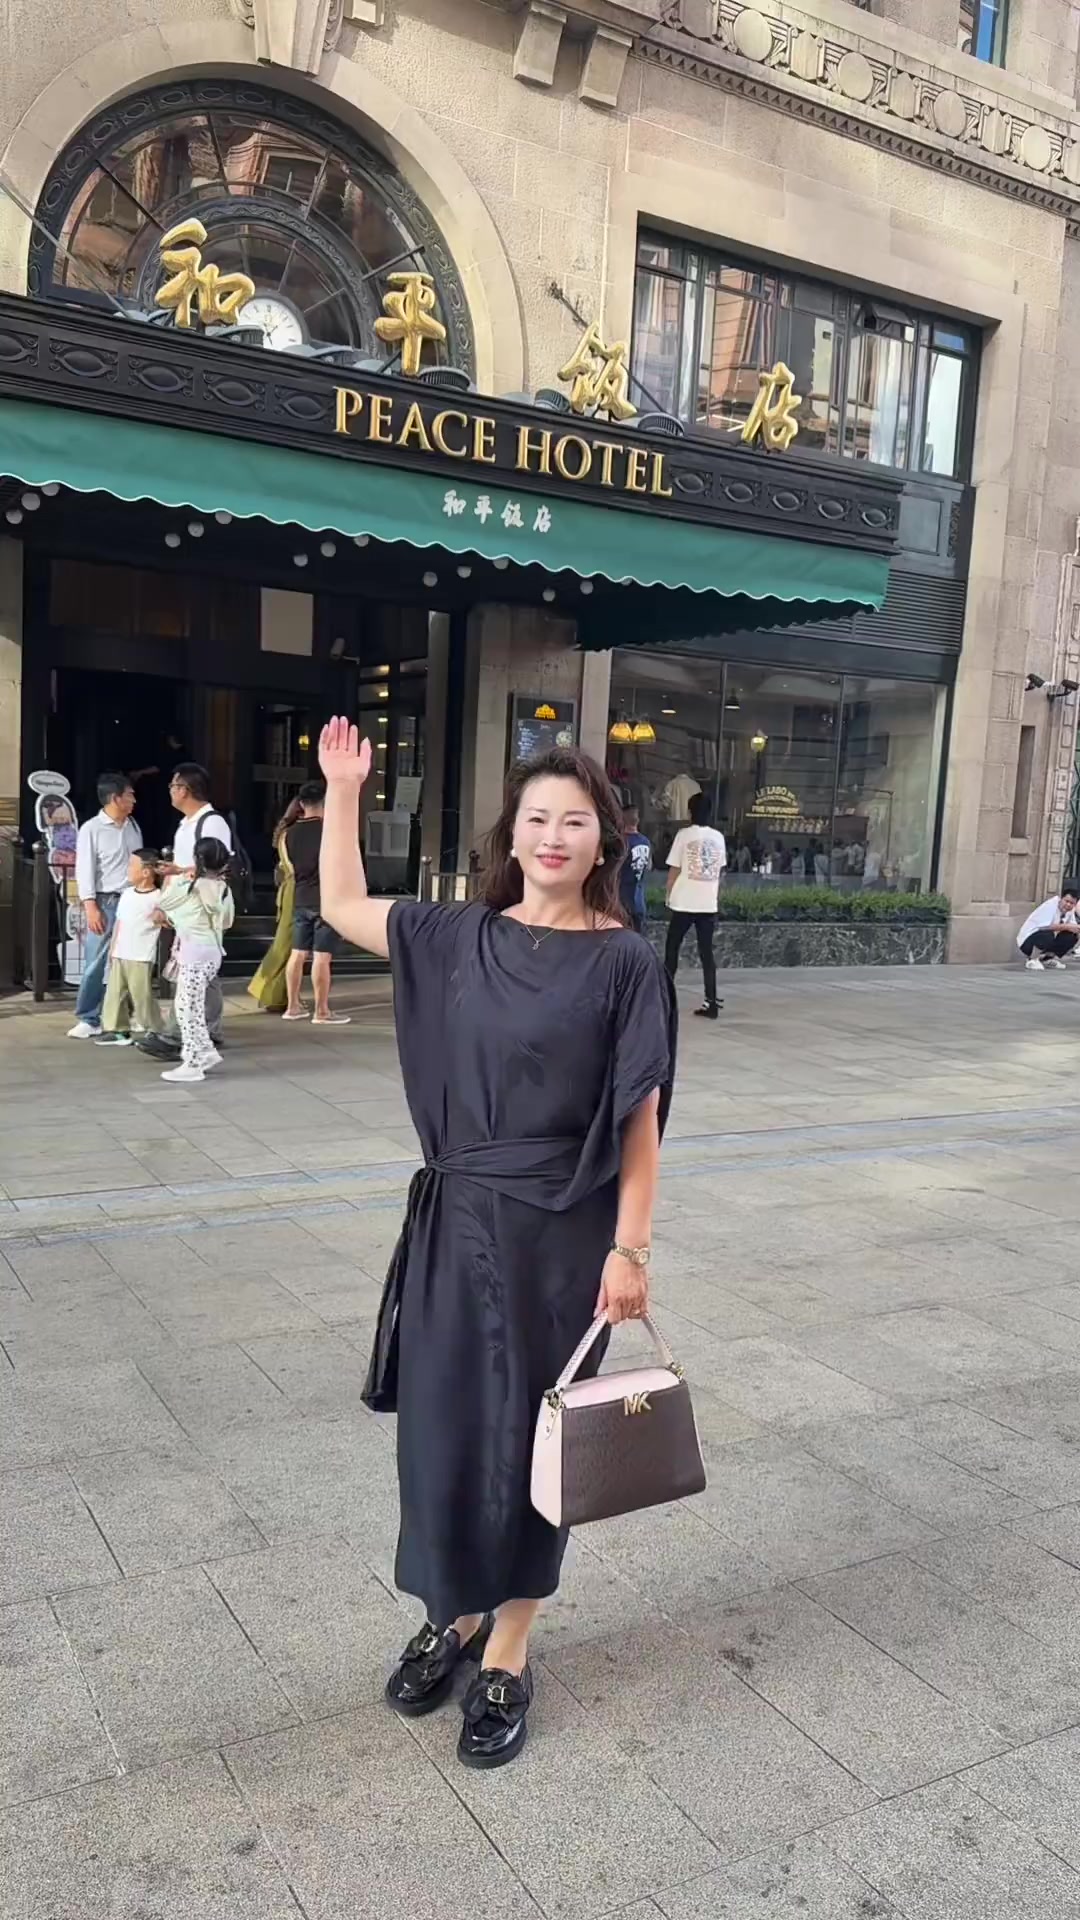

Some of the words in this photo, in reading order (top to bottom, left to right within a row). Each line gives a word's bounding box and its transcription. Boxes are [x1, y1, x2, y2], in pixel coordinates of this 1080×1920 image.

[332, 386, 497, 464] PEACE
[515, 425, 673, 497] HOTEL
[624, 1390, 652, 1416] MK
